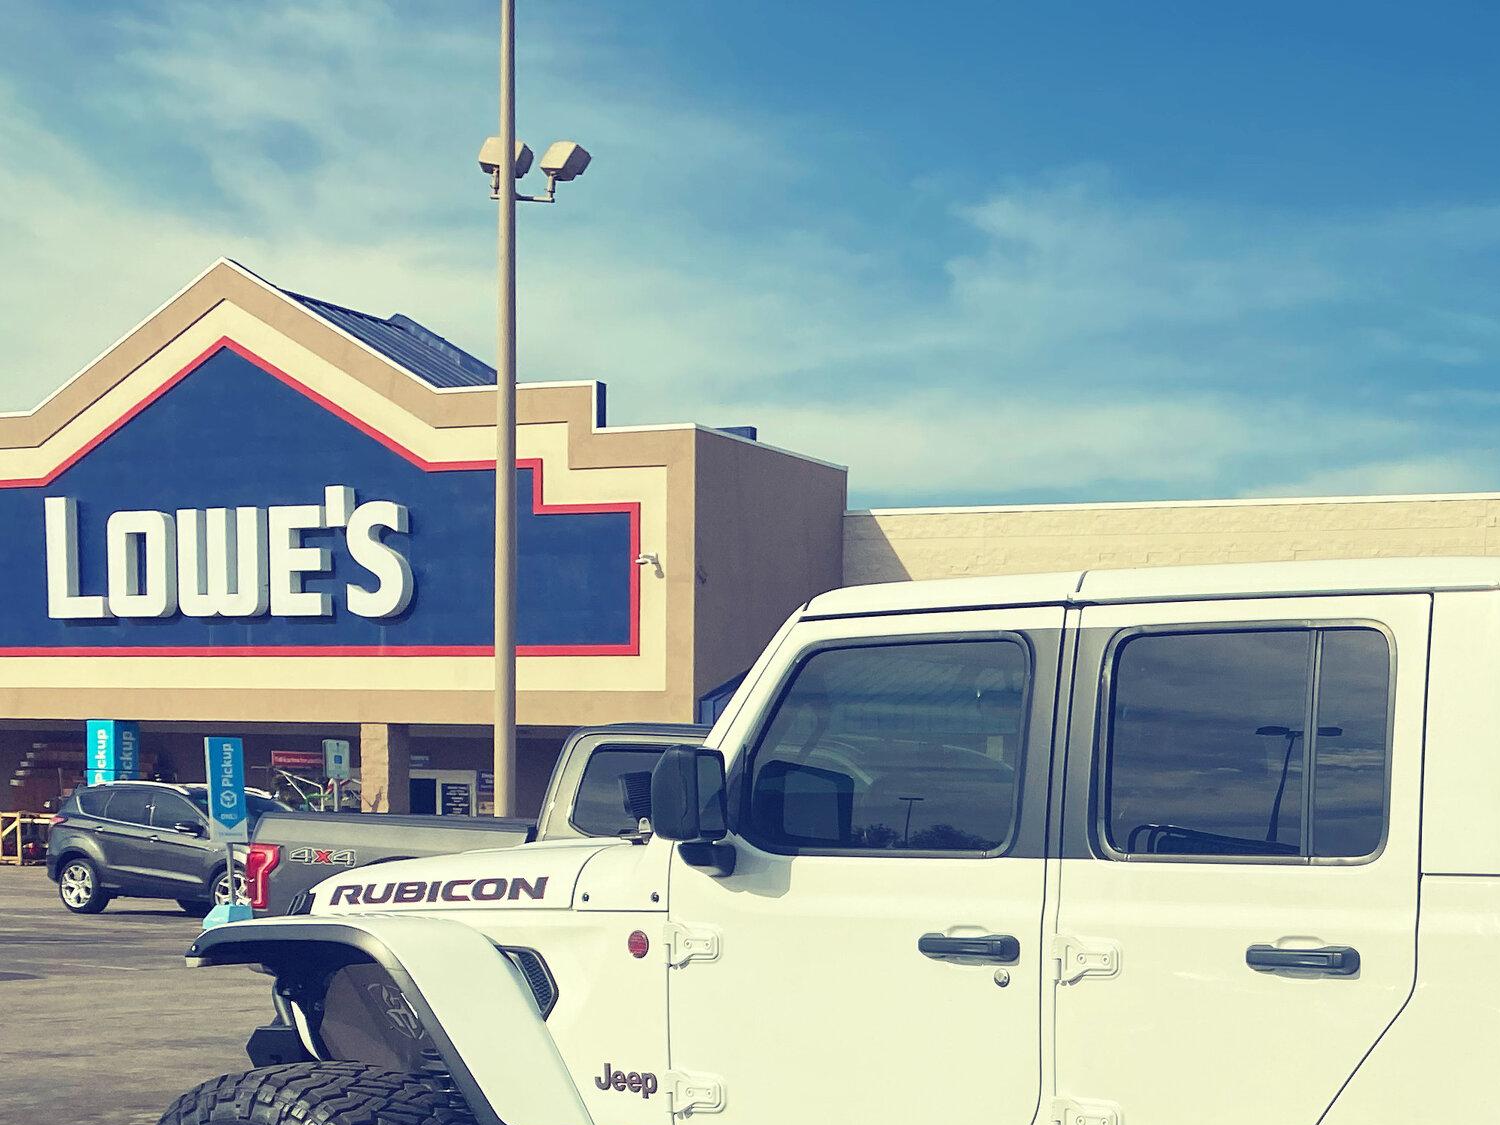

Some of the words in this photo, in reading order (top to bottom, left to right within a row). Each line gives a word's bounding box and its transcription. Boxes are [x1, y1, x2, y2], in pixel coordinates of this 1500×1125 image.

[44, 485, 412, 619] LOWE'S
[221, 743, 234, 787] Pickup
[328, 876, 550, 907] RUBICON
[594, 1062, 658, 1099] Jeep
